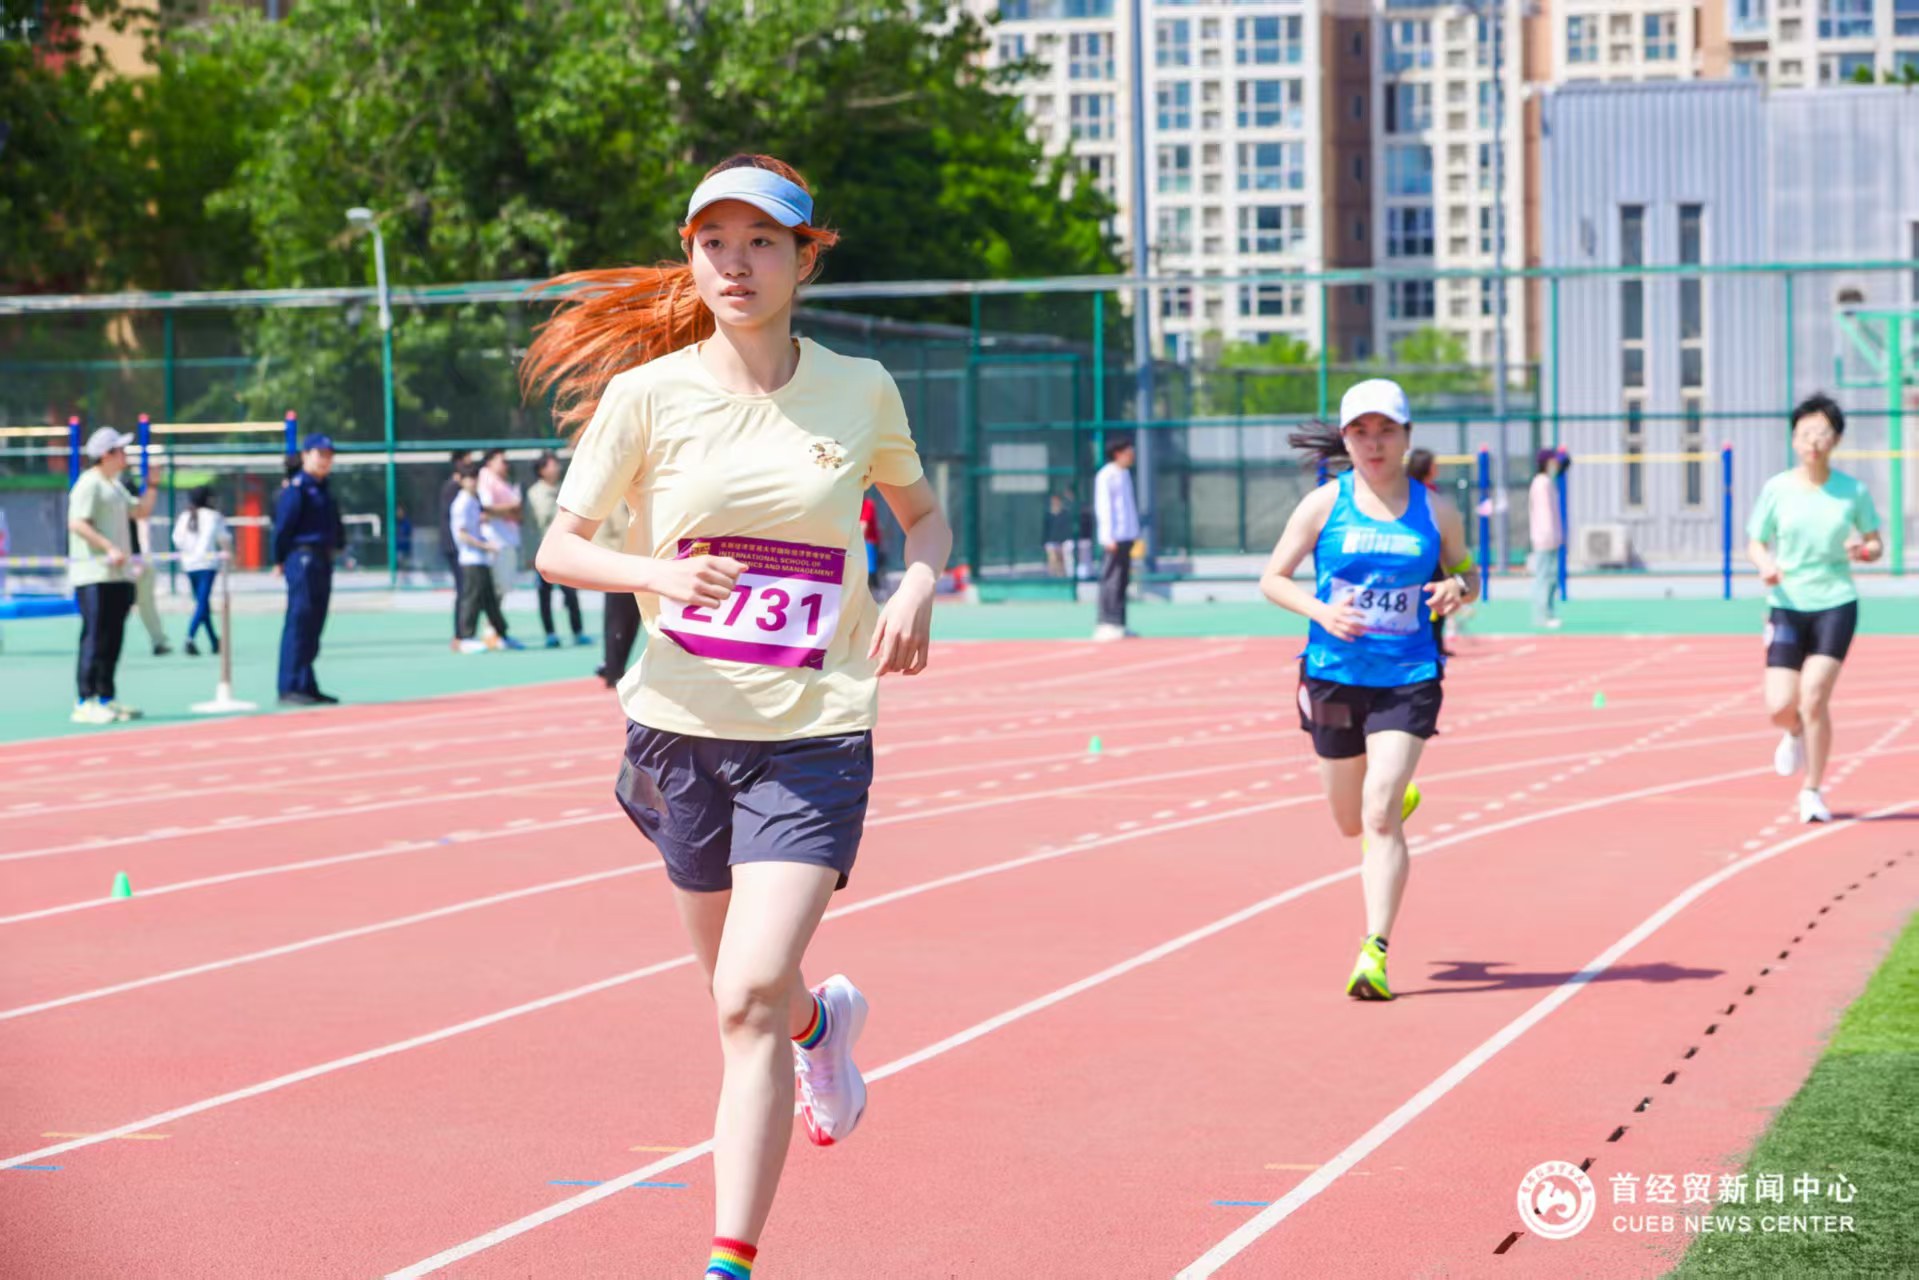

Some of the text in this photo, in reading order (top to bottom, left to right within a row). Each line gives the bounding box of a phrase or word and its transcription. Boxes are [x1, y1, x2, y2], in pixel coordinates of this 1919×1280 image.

[718, 551, 778, 563] INTERNATIONAL
[780, 558, 811, 567] SCHOOL
[781, 565, 834, 577] MANAGEMENT
